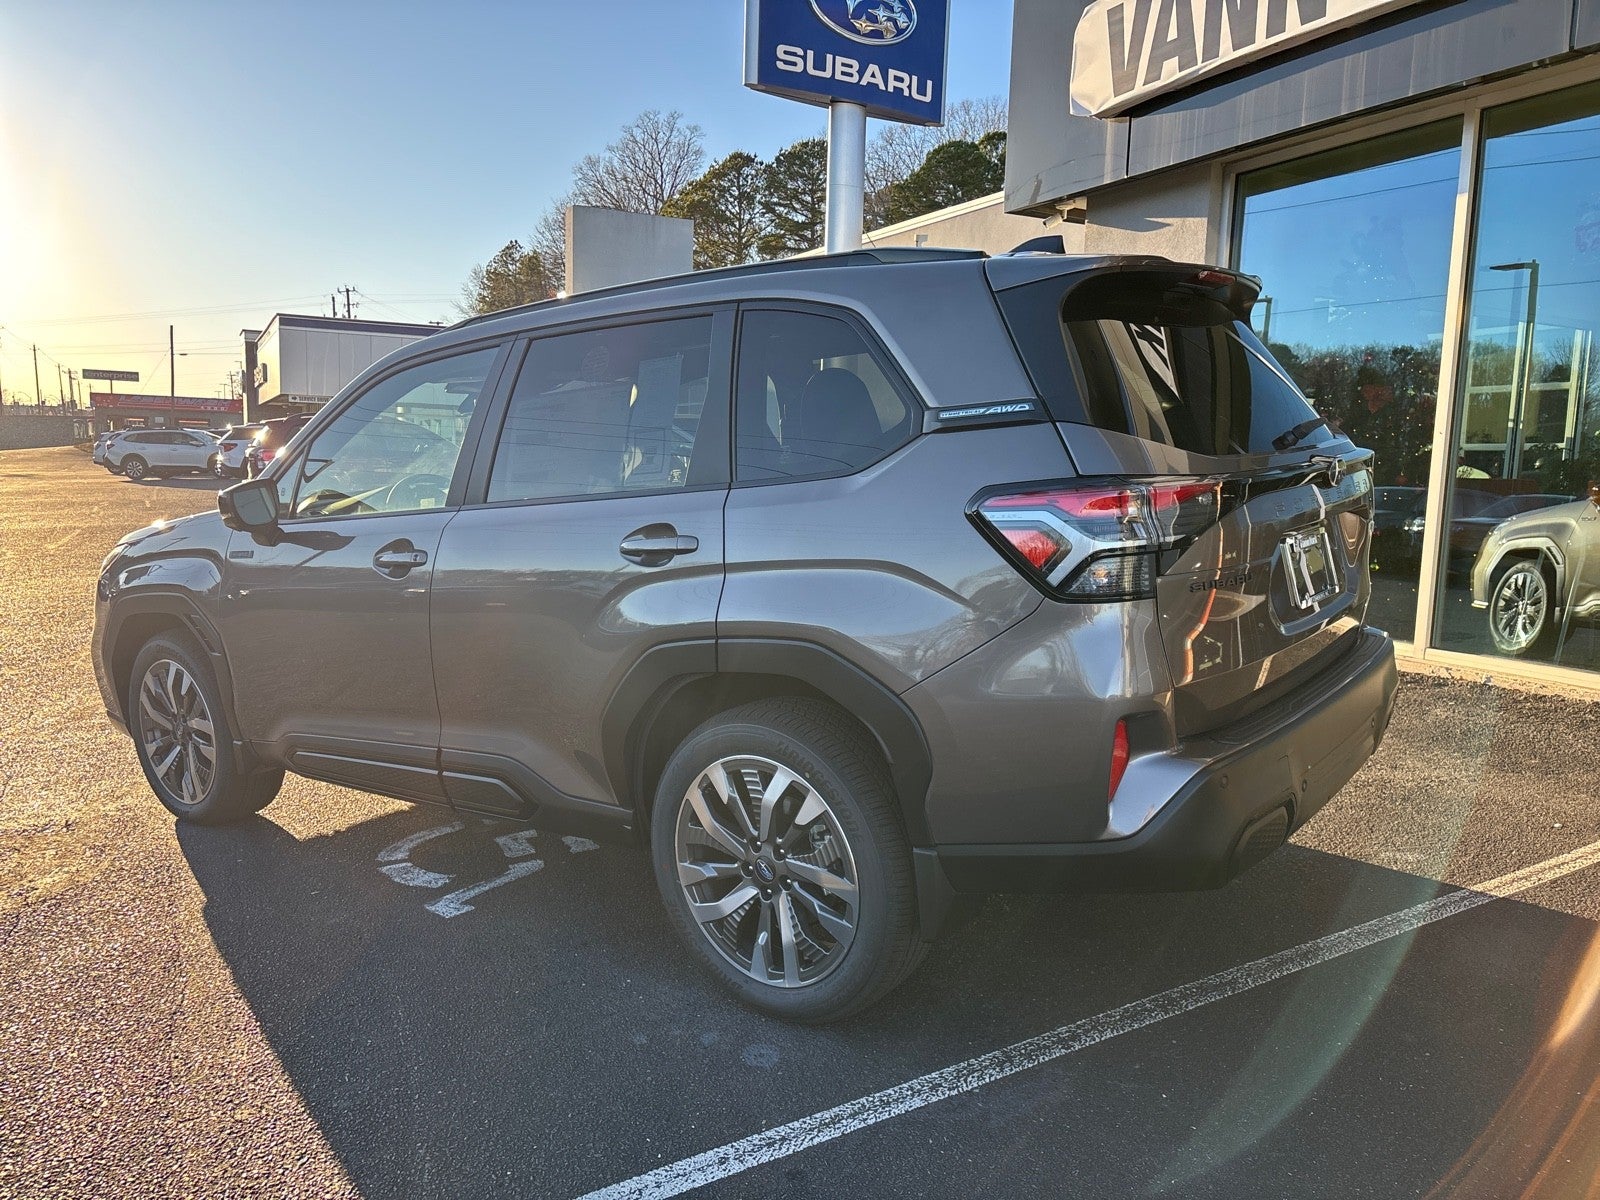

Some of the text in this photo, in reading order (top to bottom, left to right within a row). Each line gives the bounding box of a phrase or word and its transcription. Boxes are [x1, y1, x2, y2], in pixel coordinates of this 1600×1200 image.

[775, 44, 933, 103] SUBARU
[85, 371, 138, 380] enterprise
[985, 403, 1030, 414] AWD
[1190, 573, 1254, 593] SUBARU
